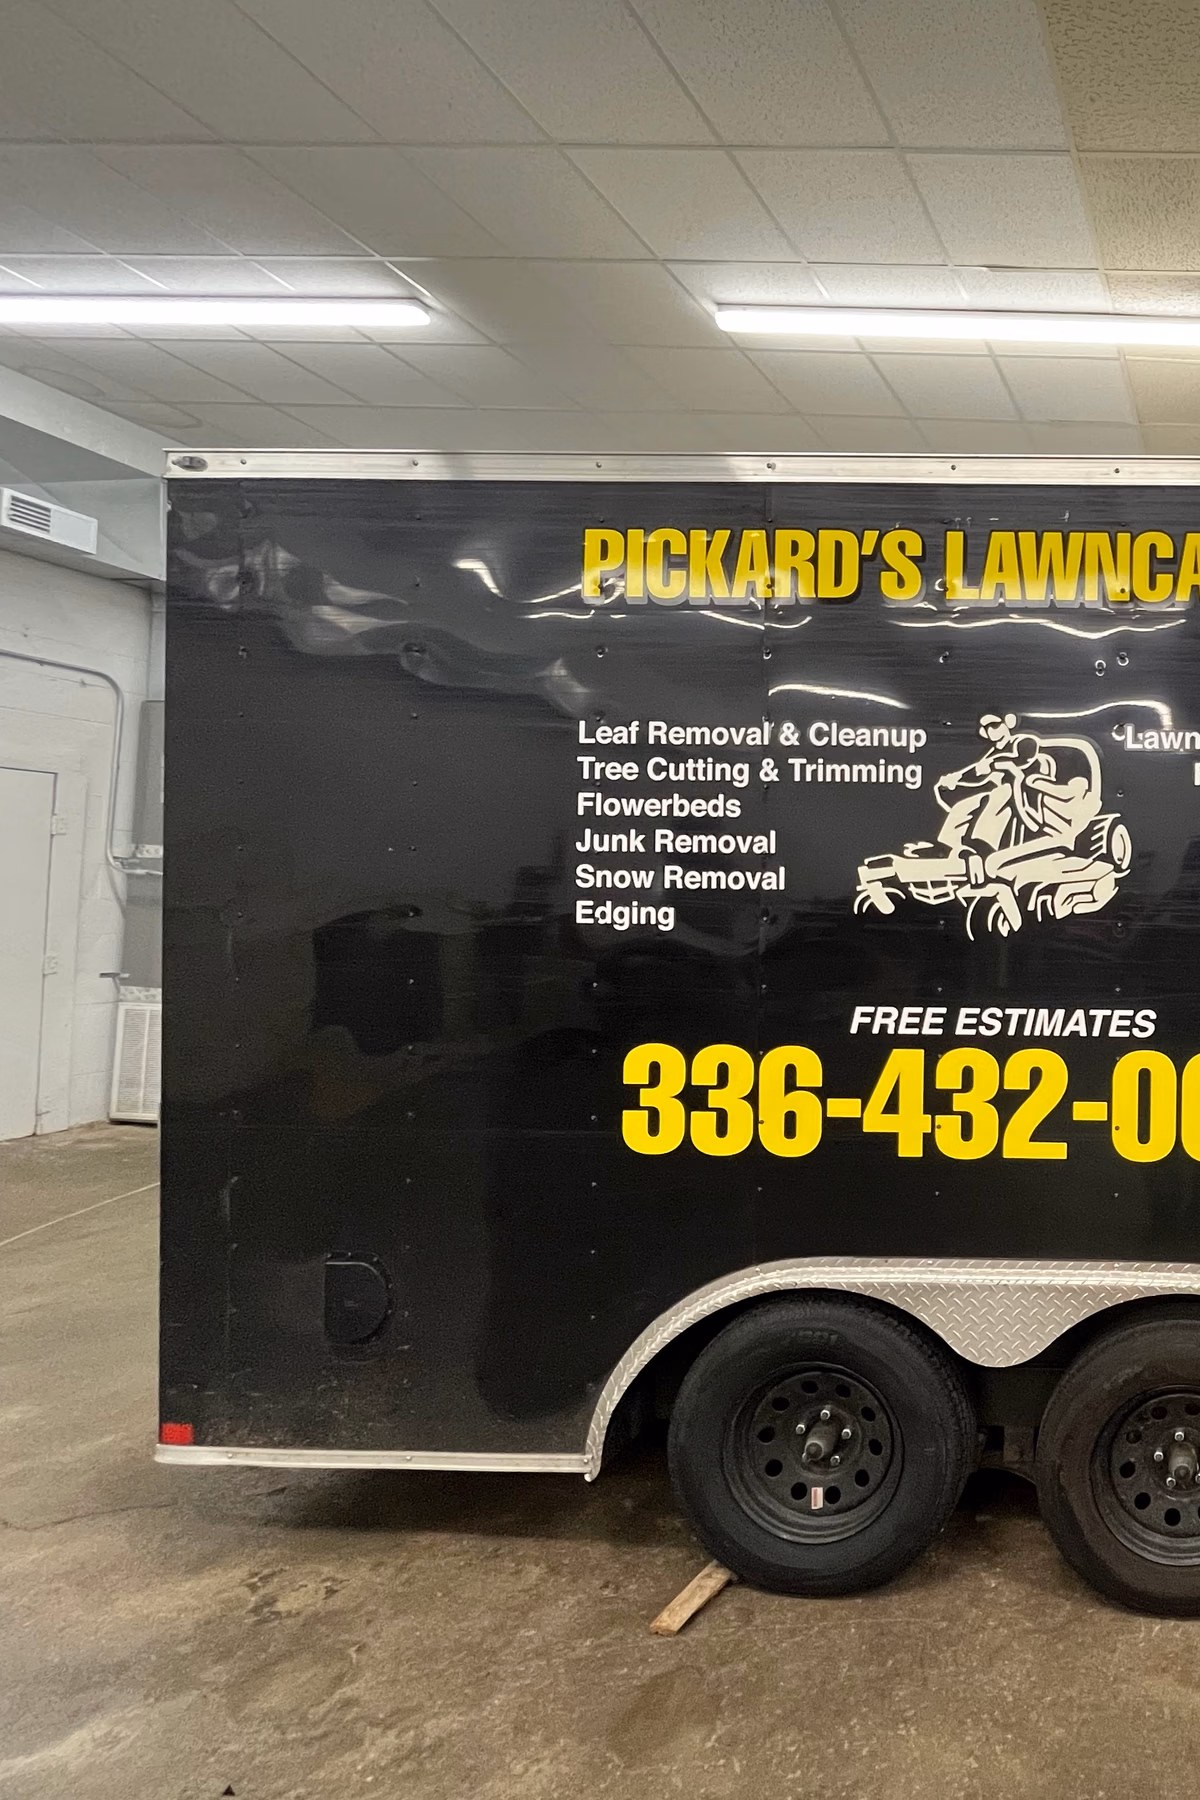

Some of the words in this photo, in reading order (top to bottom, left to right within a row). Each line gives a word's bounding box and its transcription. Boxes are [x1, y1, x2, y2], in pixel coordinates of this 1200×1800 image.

[582, 528, 924, 602] PICKARD'S
[578, 721, 639, 745] Leaf
[648, 721, 769, 746] Removal
[779, 722, 799, 746] &
[809, 722, 927, 753] Cleanup
[1125, 726, 1200, 750] Lawn
[578, 756, 638, 781] Tree
[647, 757, 749, 787] Cutting
[759, 759, 779, 782] &
[789, 759, 922, 789] Trimming
[578, 792, 741, 818] Flowerbeds
[576, 829, 645, 853] Junk
[655, 830, 776, 854] Removal
[576, 864, 653, 889] Snow
[664, 866, 785, 891] Removal
[576, 901, 675, 930] Edging
[850, 1006, 947, 1035] FREE
[956, 1008, 1156, 1038] ESTIMATES
